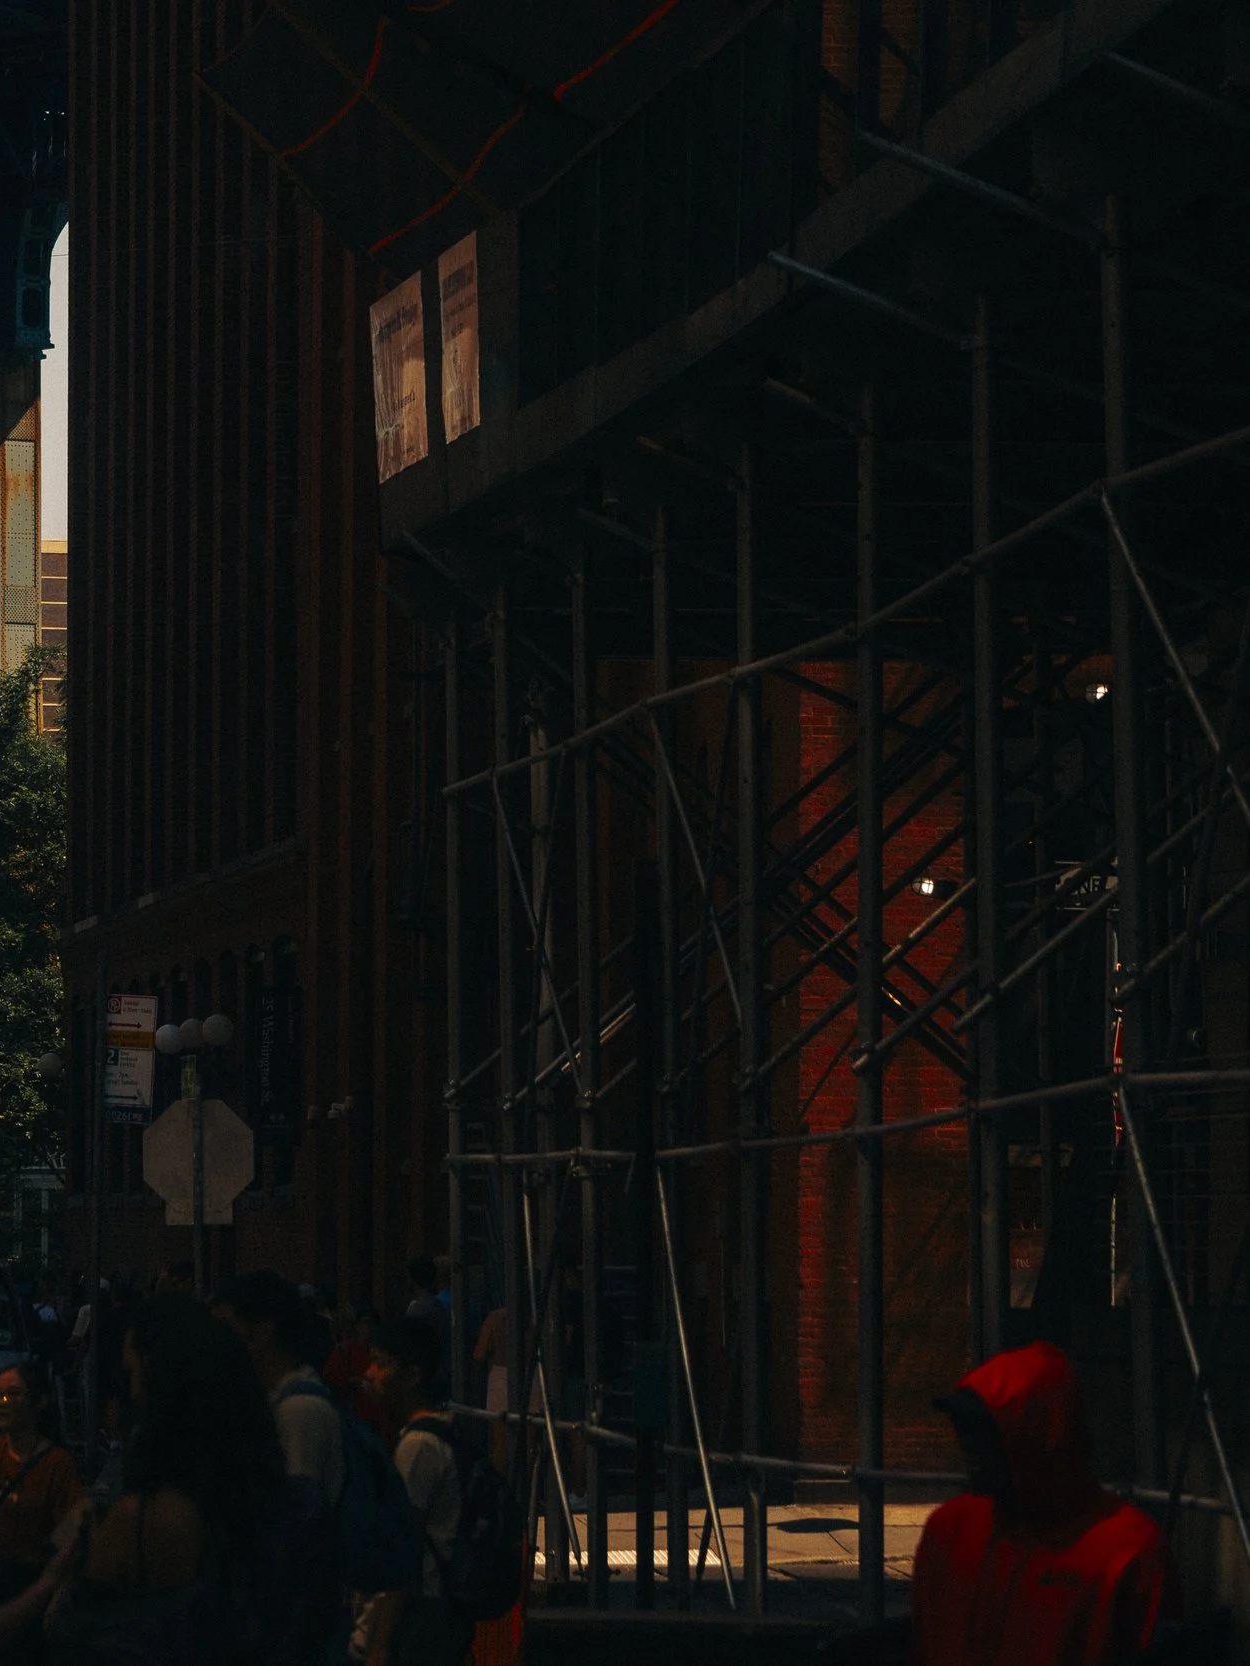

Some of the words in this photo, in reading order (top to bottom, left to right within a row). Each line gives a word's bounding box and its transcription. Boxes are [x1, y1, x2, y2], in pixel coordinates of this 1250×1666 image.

[262, 996, 274, 1012] 25
[106, 1049, 115, 1064] 2
[257, 1014, 274, 1087] Washington
